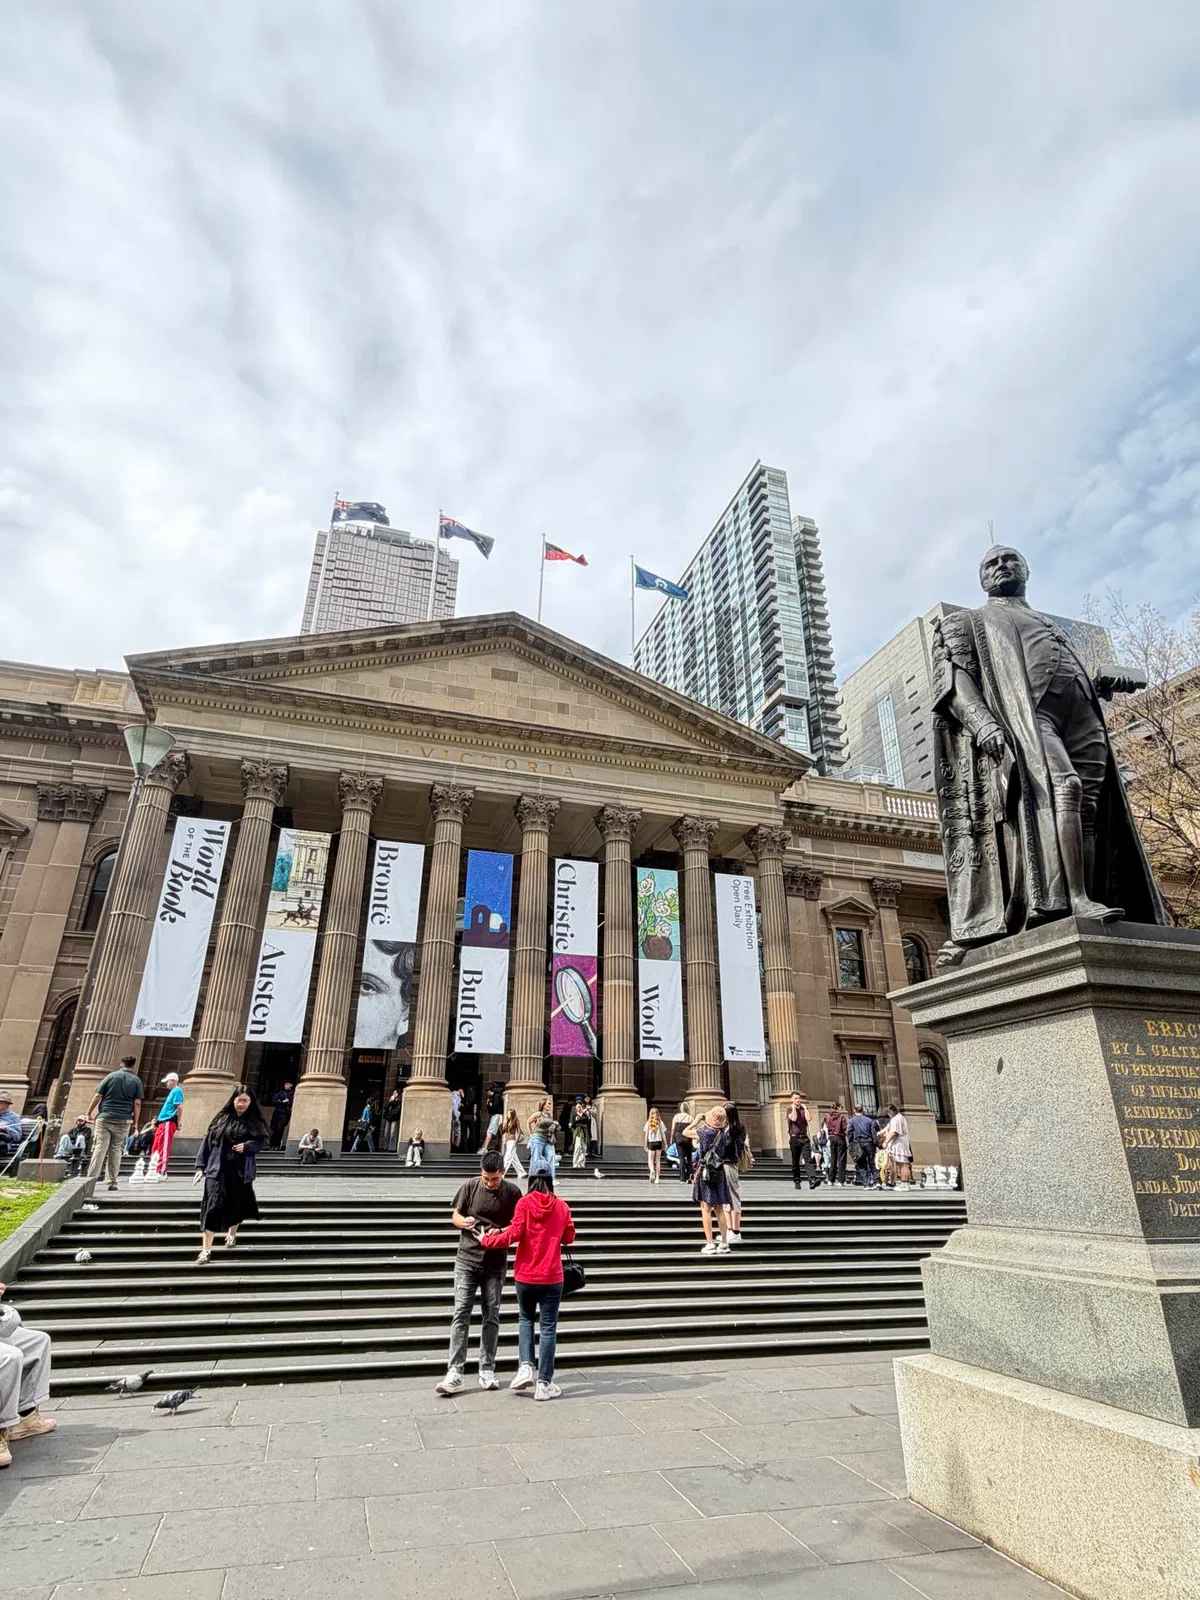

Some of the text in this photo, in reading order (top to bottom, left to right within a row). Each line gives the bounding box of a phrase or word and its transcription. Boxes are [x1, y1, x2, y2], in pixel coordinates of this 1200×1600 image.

[420, 746, 575, 778] VICTORIA
[182, 827, 195, 859] OF THE
[191, 825, 226, 900] World
[160, 859, 195, 924] Book
[370, 846, 400, 926] Brontë
[555, 862, 577, 951] Christie
[731, 878, 744, 929] Open Daily
[743, 880, 755, 950] Free Exhibition
[249, 941, 286, 1036] Austen
[458, 968, 483, 1049] Butler
[641, 983, 664, 1057] Woolf
[1144, 1020, 1200, 1039] EREC
[1111, 1062, 1200, 1078] TO PERPETUA
[1135, 1043, 1147, 1056] A
[1122, 1105, 1193, 1120] RENDERED
[1148, 1085, 1200, 1099] INVALU
[1123, 1127, 1160, 1148] SIR
[1135, 1179, 1161, 1194] AND
